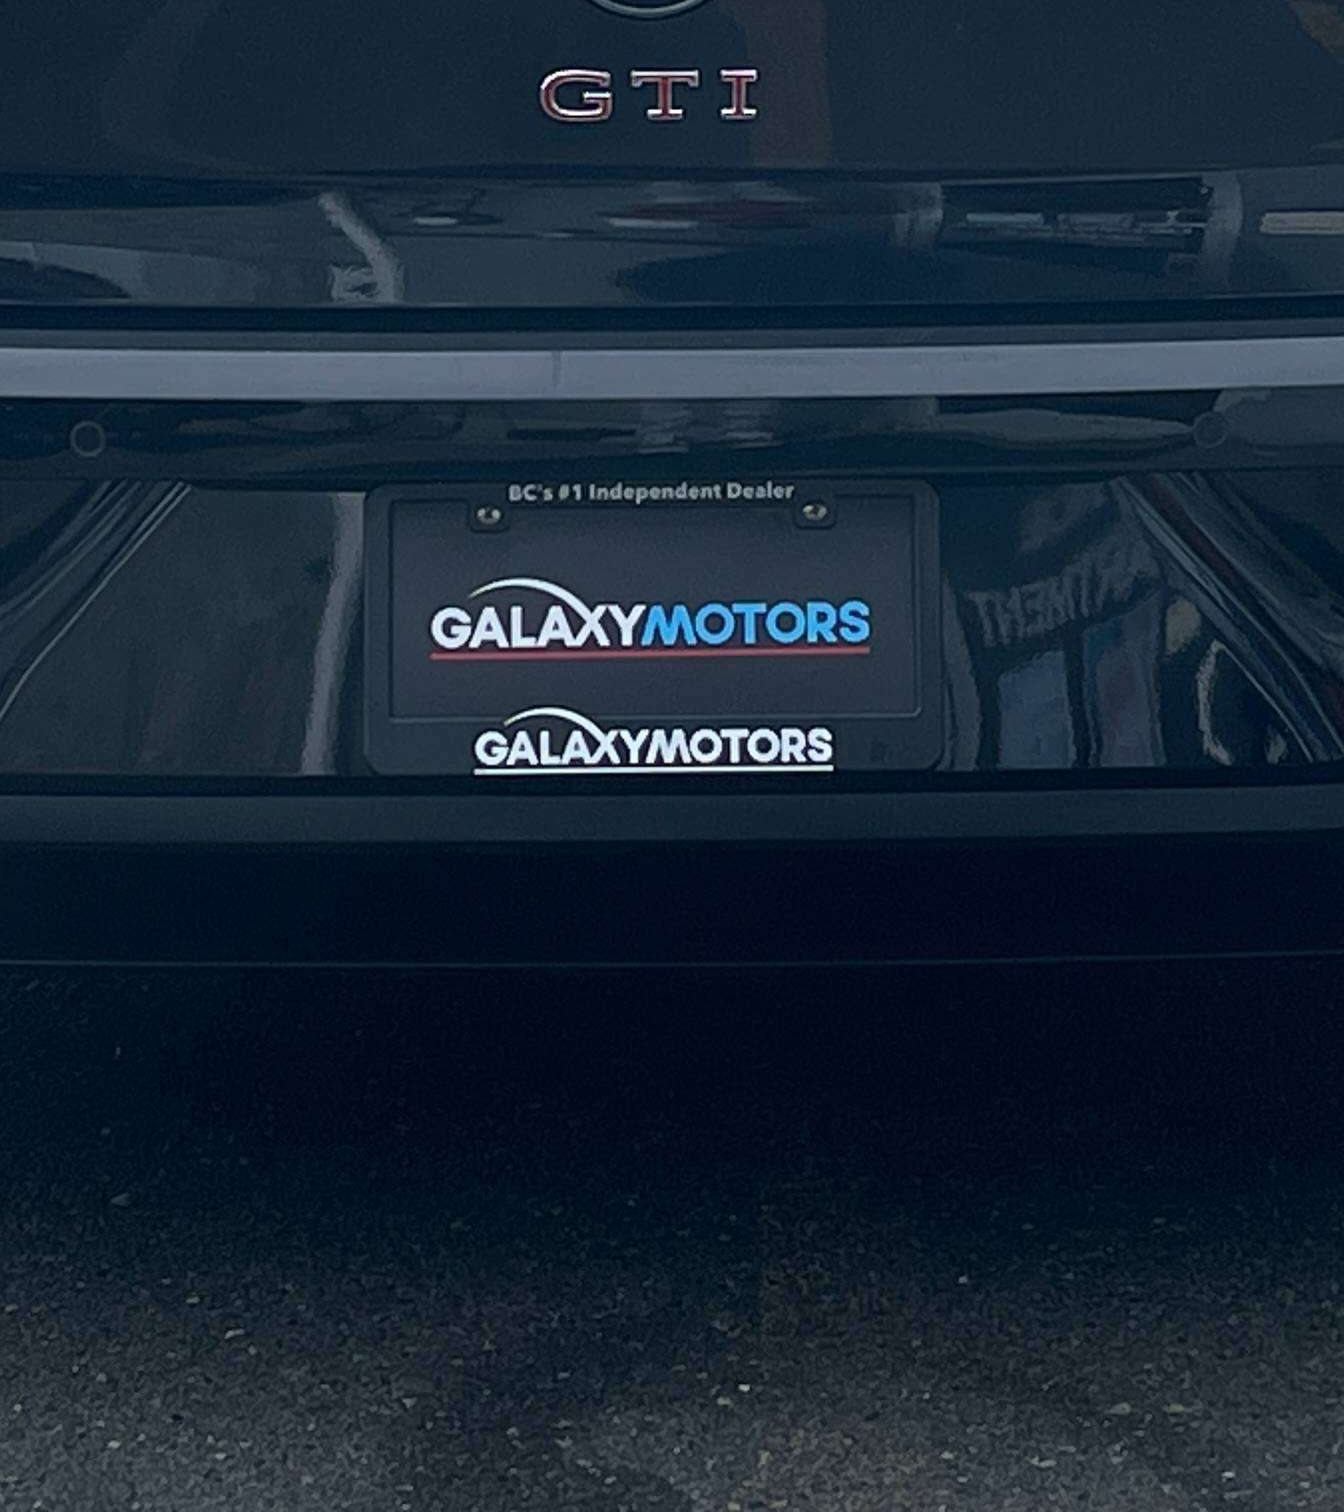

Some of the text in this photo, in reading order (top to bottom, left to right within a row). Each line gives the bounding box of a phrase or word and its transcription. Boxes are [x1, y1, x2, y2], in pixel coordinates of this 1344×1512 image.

[540, 69, 757, 121] GTI
[508, 481, 795, 504] BC's #1 Independent Dealer
